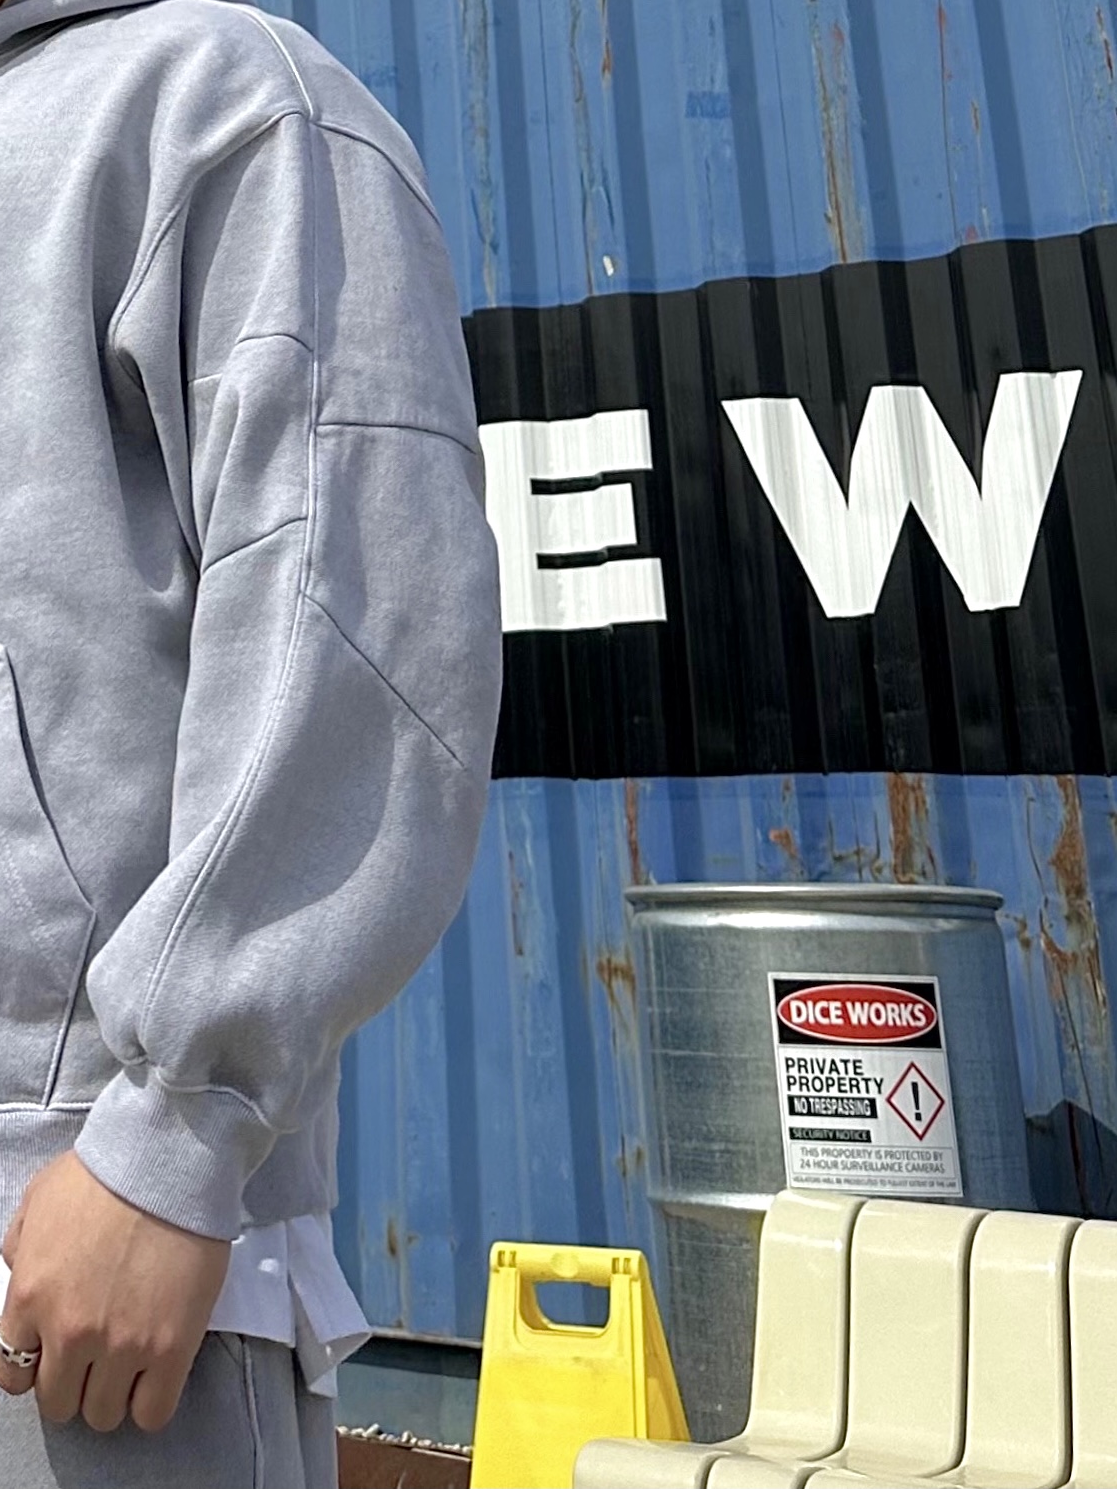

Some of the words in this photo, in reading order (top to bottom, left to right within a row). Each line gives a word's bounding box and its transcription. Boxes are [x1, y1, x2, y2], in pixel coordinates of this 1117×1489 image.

[789, 1000, 844, 1025] DICE
[846, 1001, 926, 1028] WORKS
[785, 1056, 865, 1076] PRIVATE
[786, 1075, 885, 1095] PROPERTY
[794, 1097, 808, 1114] NO
[809, 1097, 872, 1116] TRESPASSING
[792, 1128, 834, 1140] SECURITY
[836, 1130, 868, 1141] NOTICE
[800, 1147, 819, 1158] THIS
[875, 1149, 882, 1160] IS
[884, 1150, 932, 1161] PROTECTED
[933, 1151, 944, 1162] BY
[800, 1159, 811, 1169] 24
[813, 1159, 839, 1170] HOUR
[841, 1160, 903, 1173] SURVEILLANCE
[905, 1162, 945, 1174] CAMERAS
